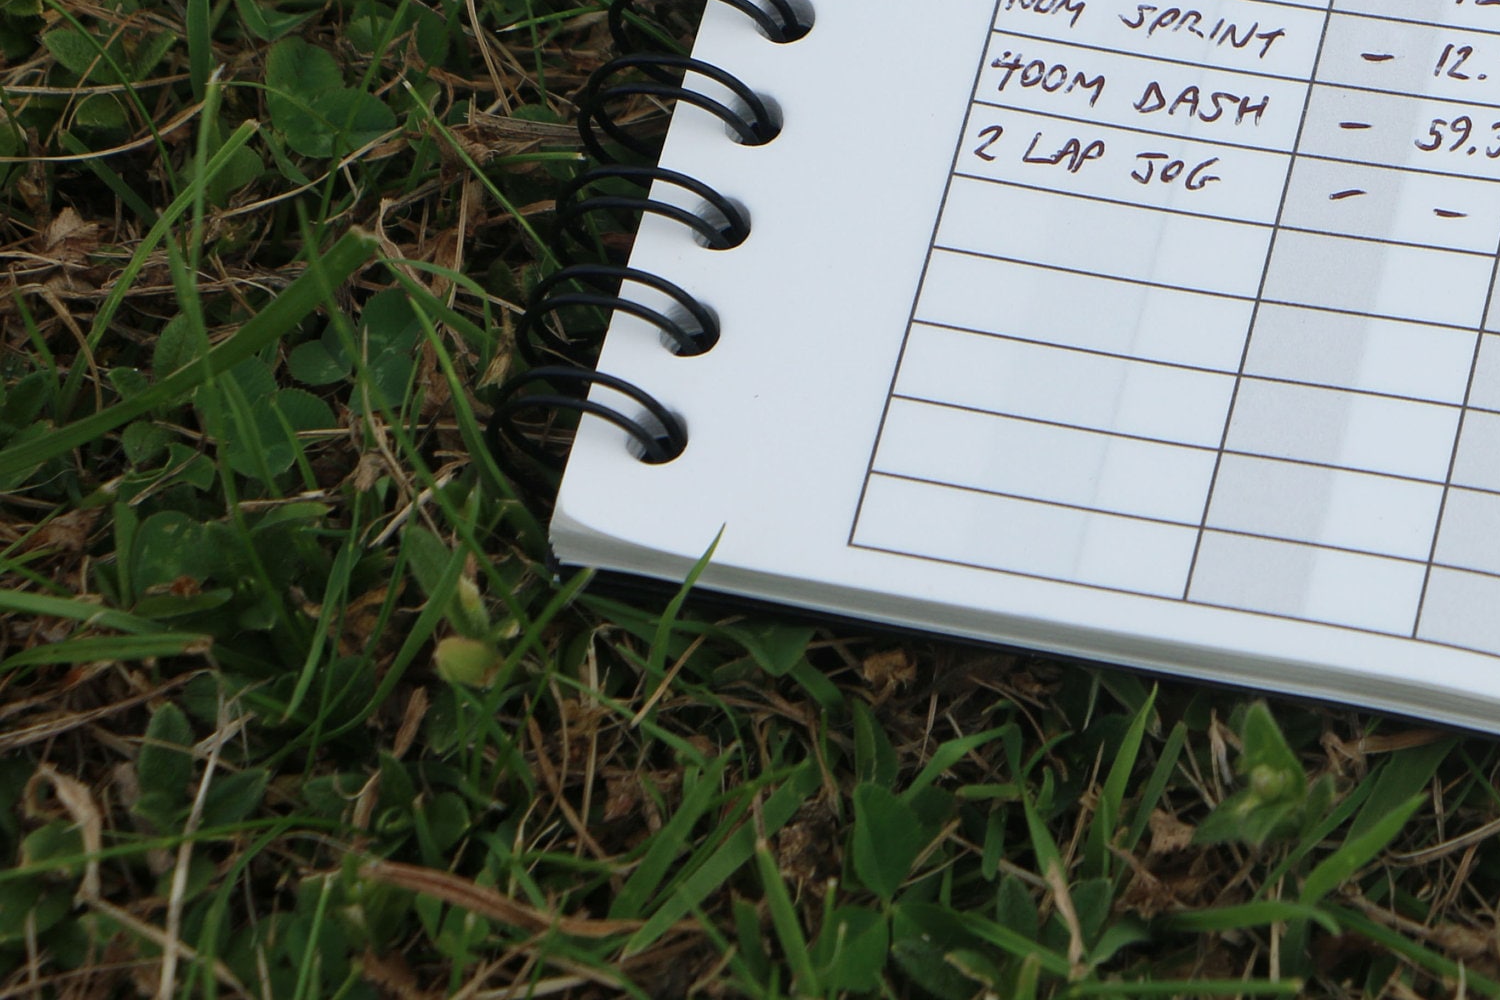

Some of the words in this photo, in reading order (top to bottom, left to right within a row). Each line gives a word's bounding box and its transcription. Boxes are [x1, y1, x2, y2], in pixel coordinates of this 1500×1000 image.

[1119, 1, 1285, 59] SPRINT
[991, 51, 1106, 107] 400M
[1134, 82, 1269, 126] DASH
[973, 124, 1003, 162] 2
[1022, 132, 1105, 171] LAP
[1131, 152, 1221, 191] JOG
